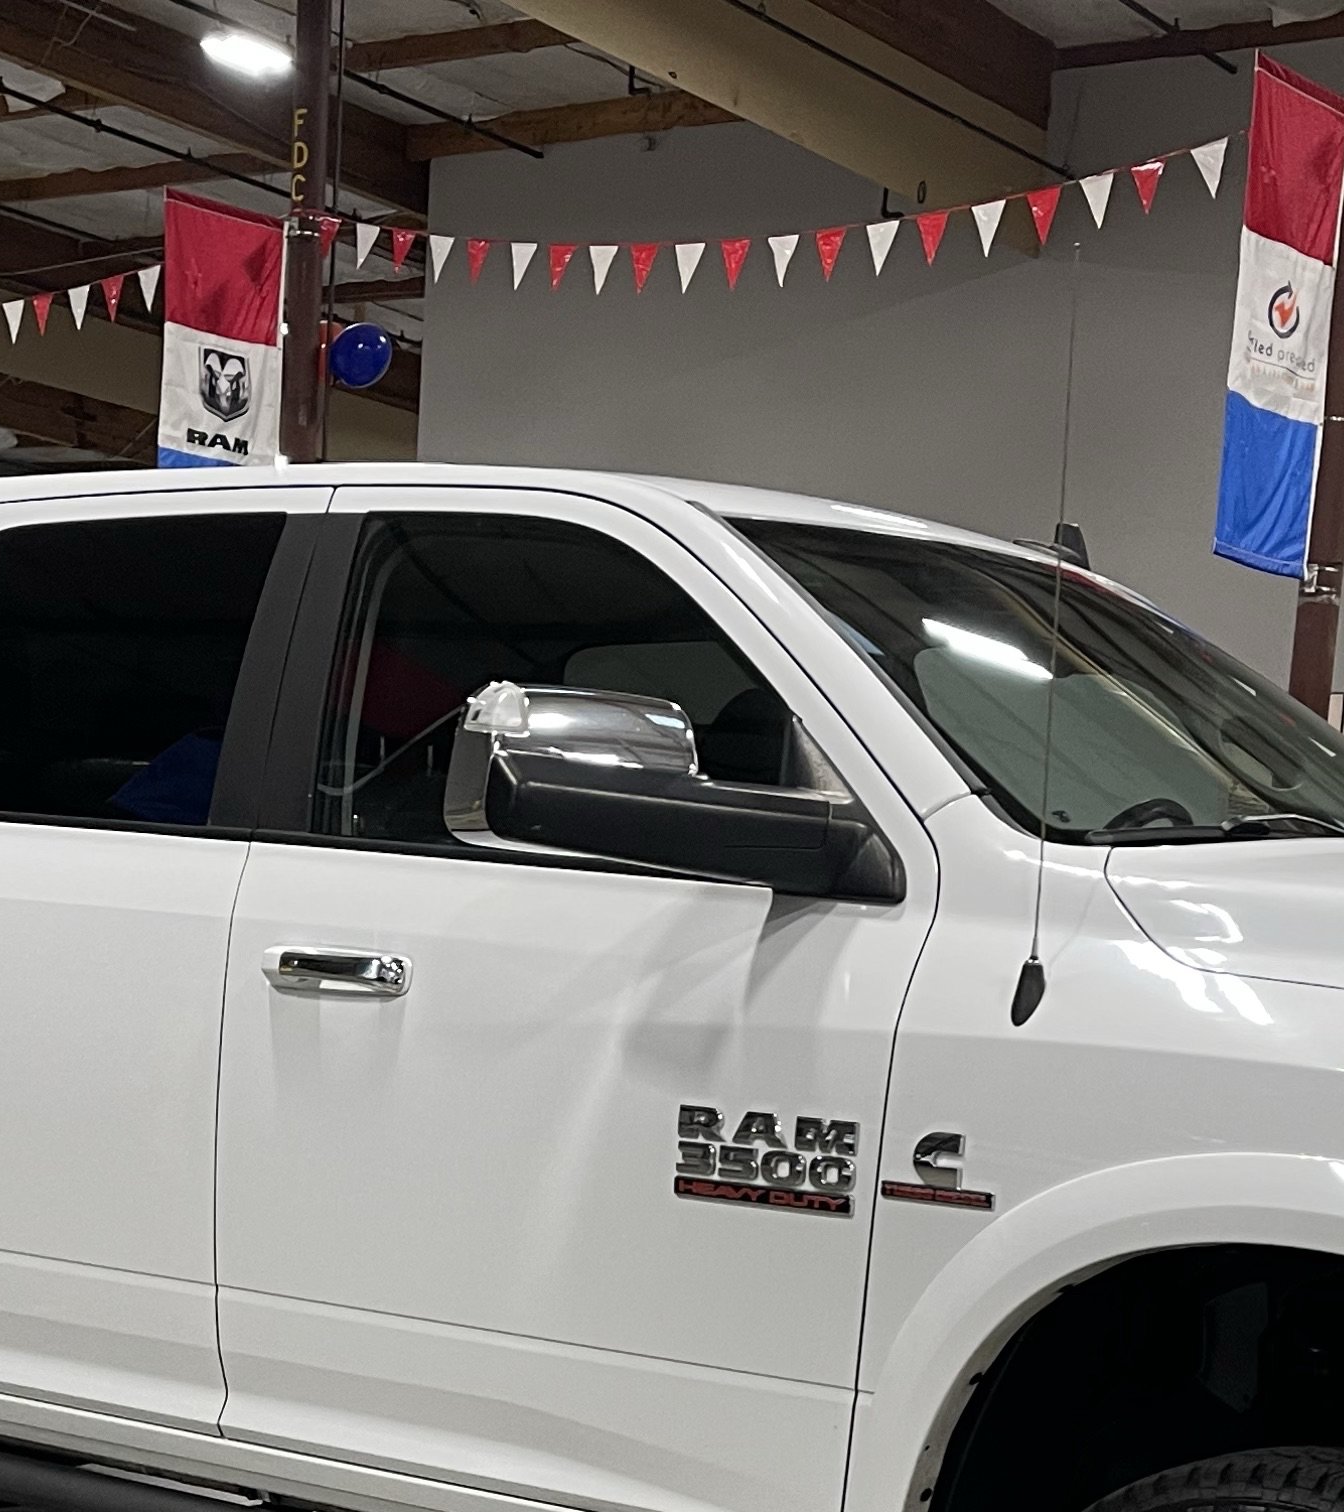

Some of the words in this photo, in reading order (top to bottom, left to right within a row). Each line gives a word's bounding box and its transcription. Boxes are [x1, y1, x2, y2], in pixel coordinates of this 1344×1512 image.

[291, 107, 309, 202] FDC
[186, 427, 249, 456] RAM
[677, 1104, 861, 1157] RAM
[675, 1140, 857, 1193] 3500
[678, 1180, 766, 1202] HEAVY
[769, 1190, 846, 1211] DUTY
